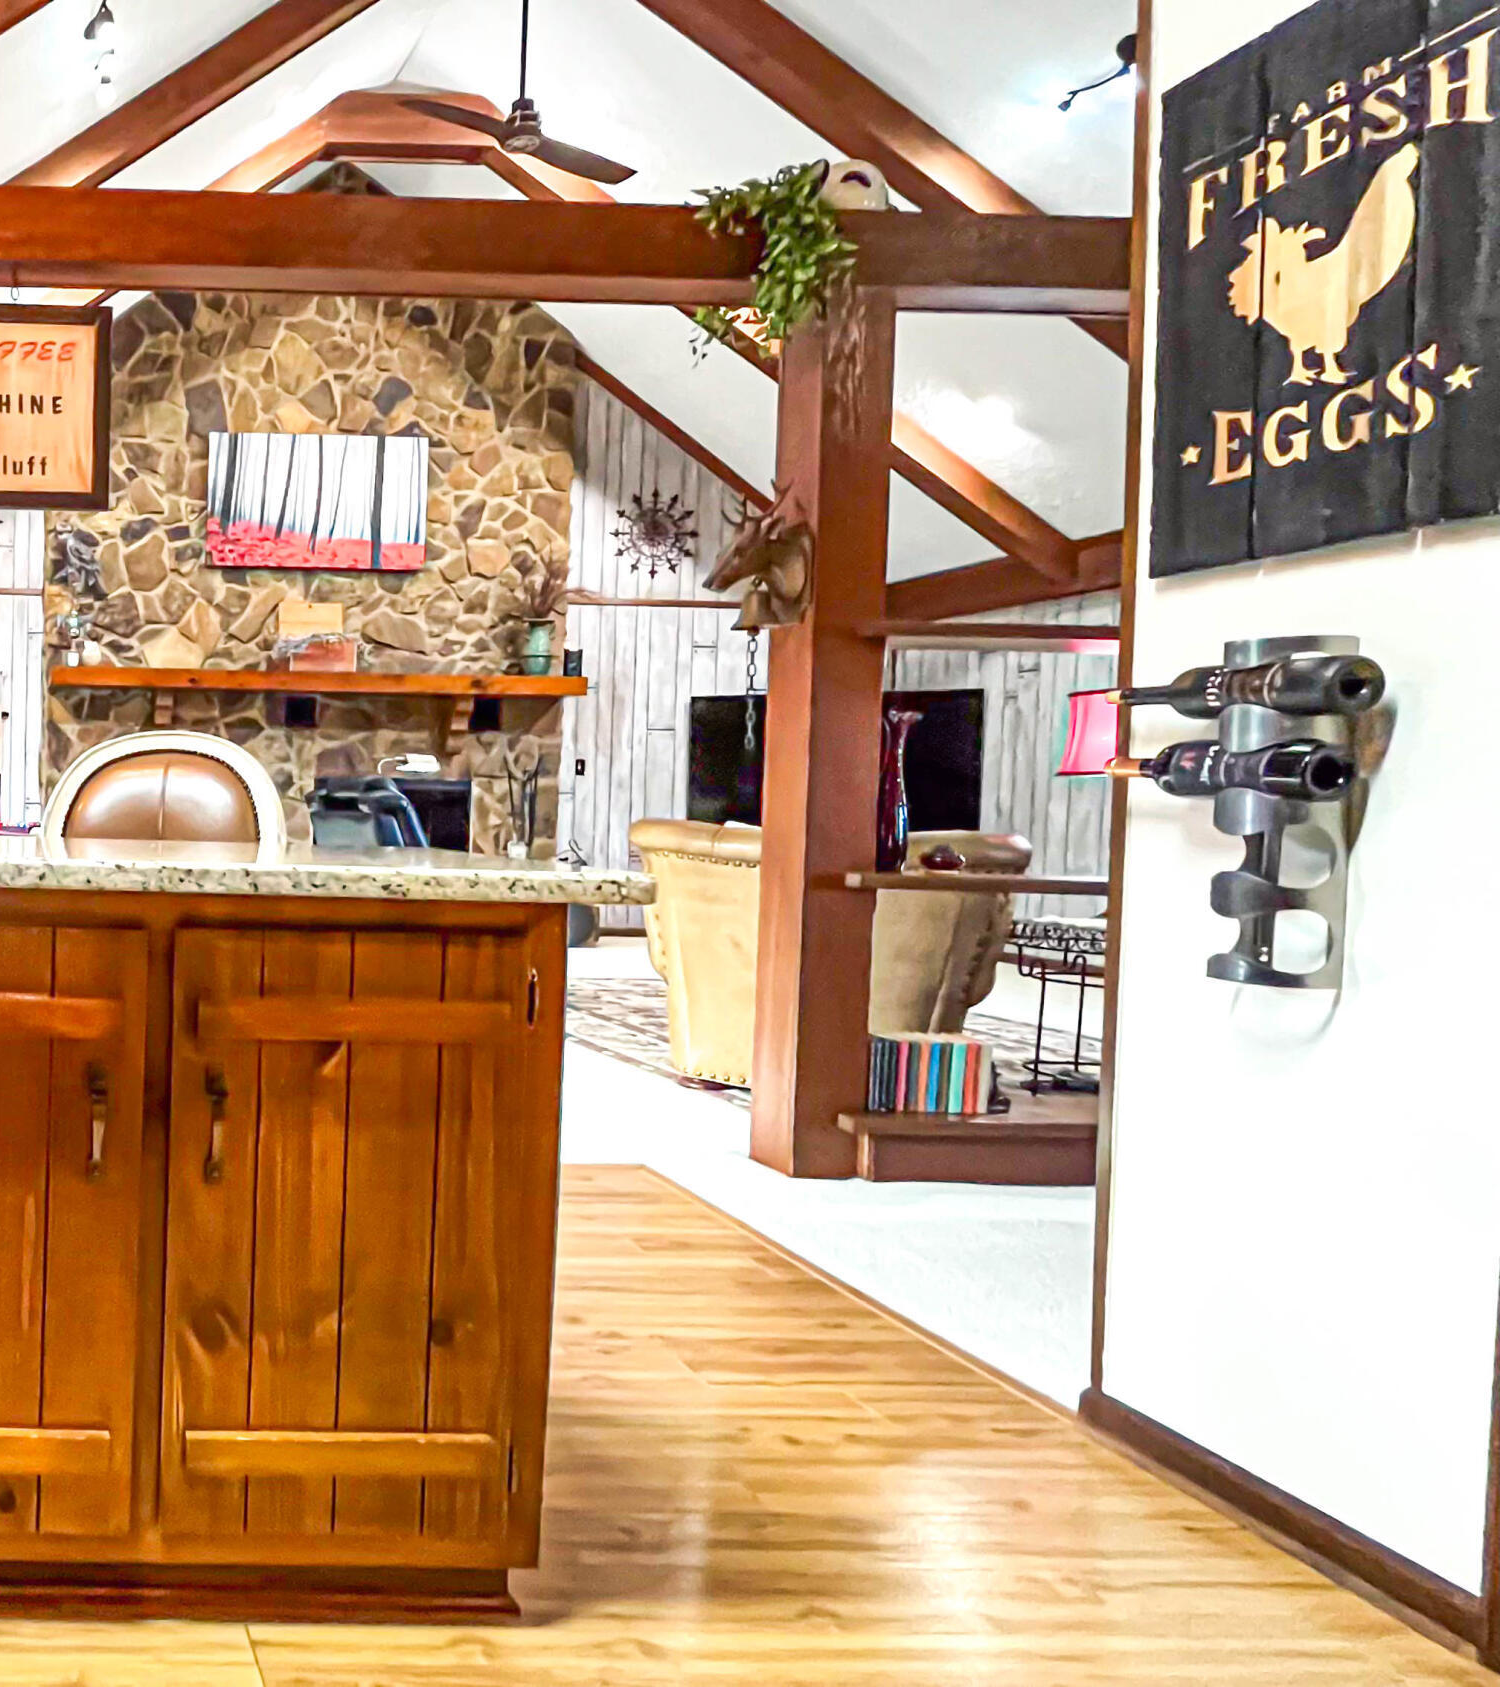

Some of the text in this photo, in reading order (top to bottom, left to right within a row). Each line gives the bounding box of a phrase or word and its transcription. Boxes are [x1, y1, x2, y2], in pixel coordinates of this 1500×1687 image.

[1187, 26, 1499, 252] FRESH
[1267, 56, 1393, 134] FARM
[1209, 343, 1438, 486] EGGS
